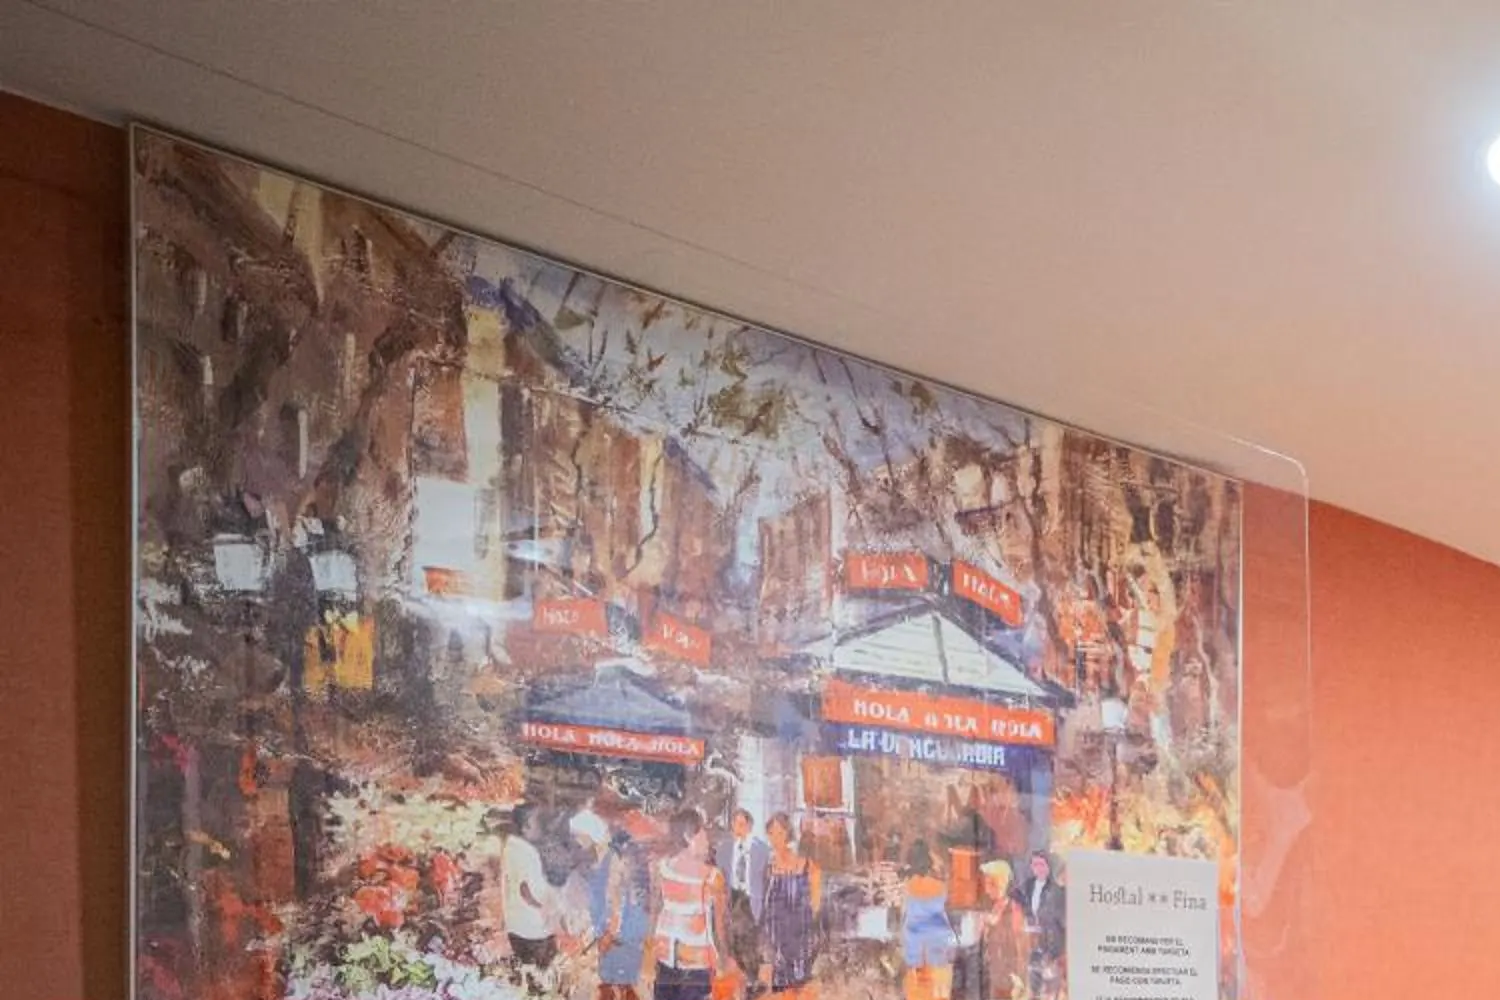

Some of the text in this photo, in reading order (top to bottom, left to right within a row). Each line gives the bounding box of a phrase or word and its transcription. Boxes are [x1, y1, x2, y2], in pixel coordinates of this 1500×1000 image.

[853, 699, 911, 722] HOLA
[522, 722, 577, 743] HOLA
[1089, 883, 1208, 911] Hostal Fina
